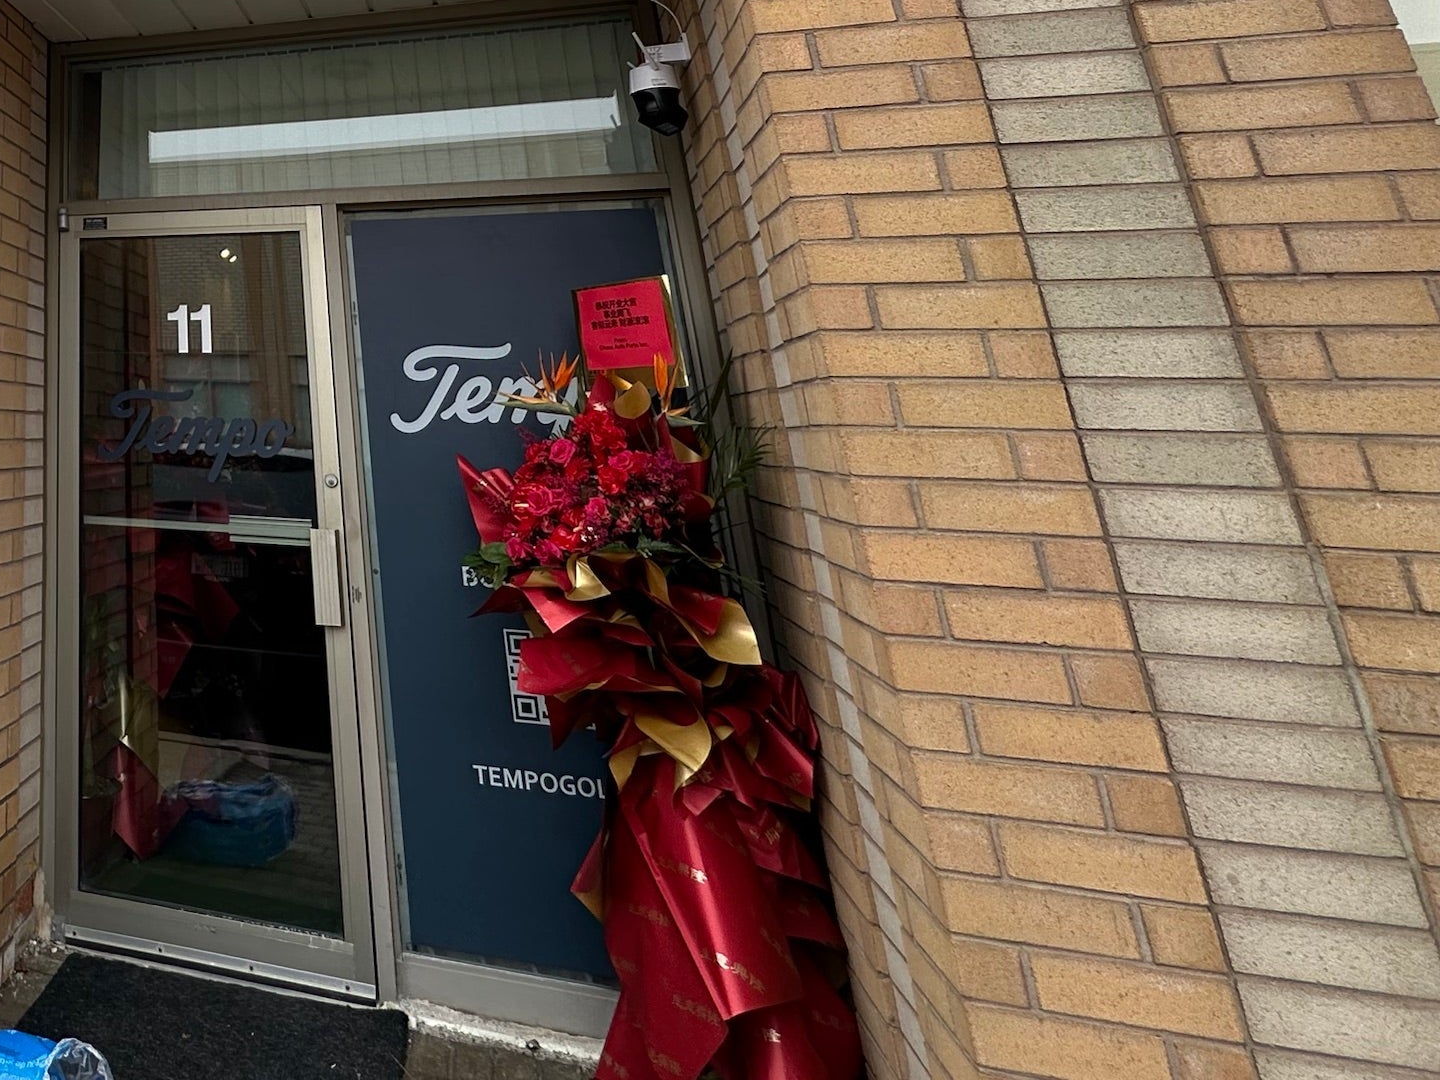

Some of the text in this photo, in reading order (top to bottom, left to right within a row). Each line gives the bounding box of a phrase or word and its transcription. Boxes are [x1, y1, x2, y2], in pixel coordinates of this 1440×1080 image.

[166, 304, 213, 354] 11
[390, 343, 578, 440] Tem
[98, 389, 295, 482] Tempo
[472, 764, 606, 799] TEMPOGOL
